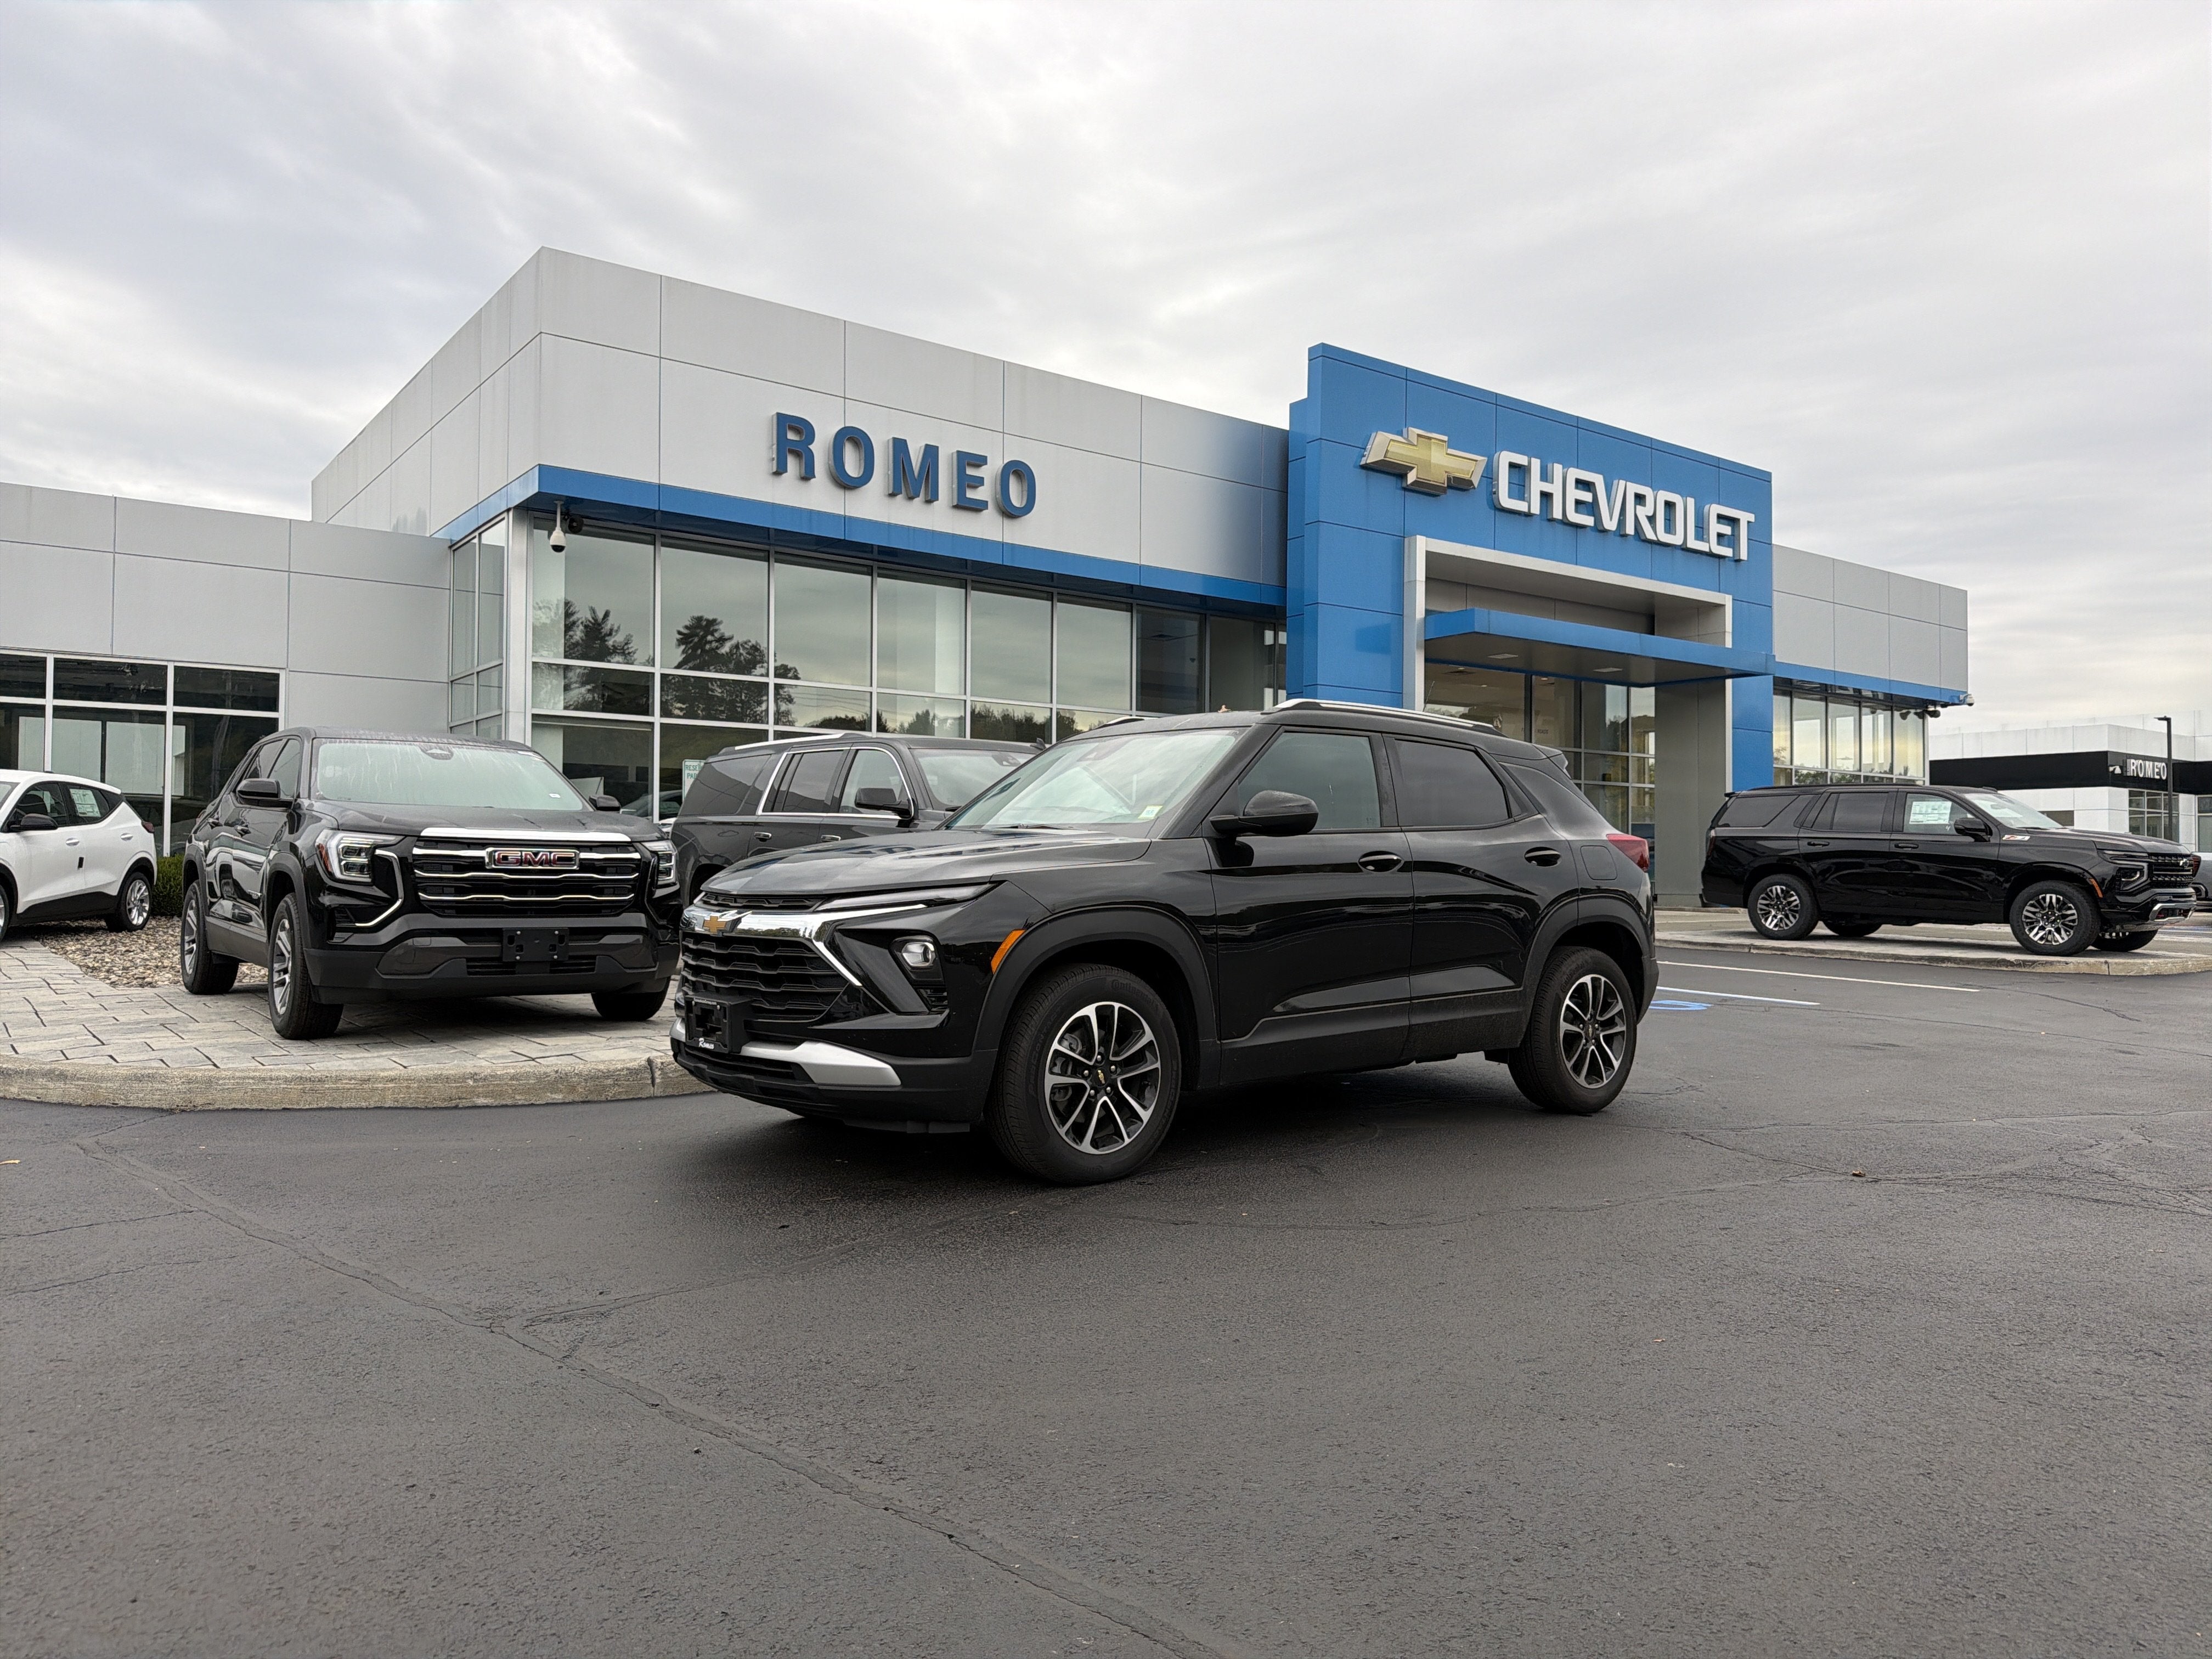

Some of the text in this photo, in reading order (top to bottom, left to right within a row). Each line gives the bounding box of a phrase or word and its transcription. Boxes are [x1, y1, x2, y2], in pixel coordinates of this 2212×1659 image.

[772, 412, 1036, 518] ROMEO
[1492, 450, 1755, 562] CHEVROLET
[2127, 759, 2167, 780] ROMEO
[495, 851, 575, 867] GMC
